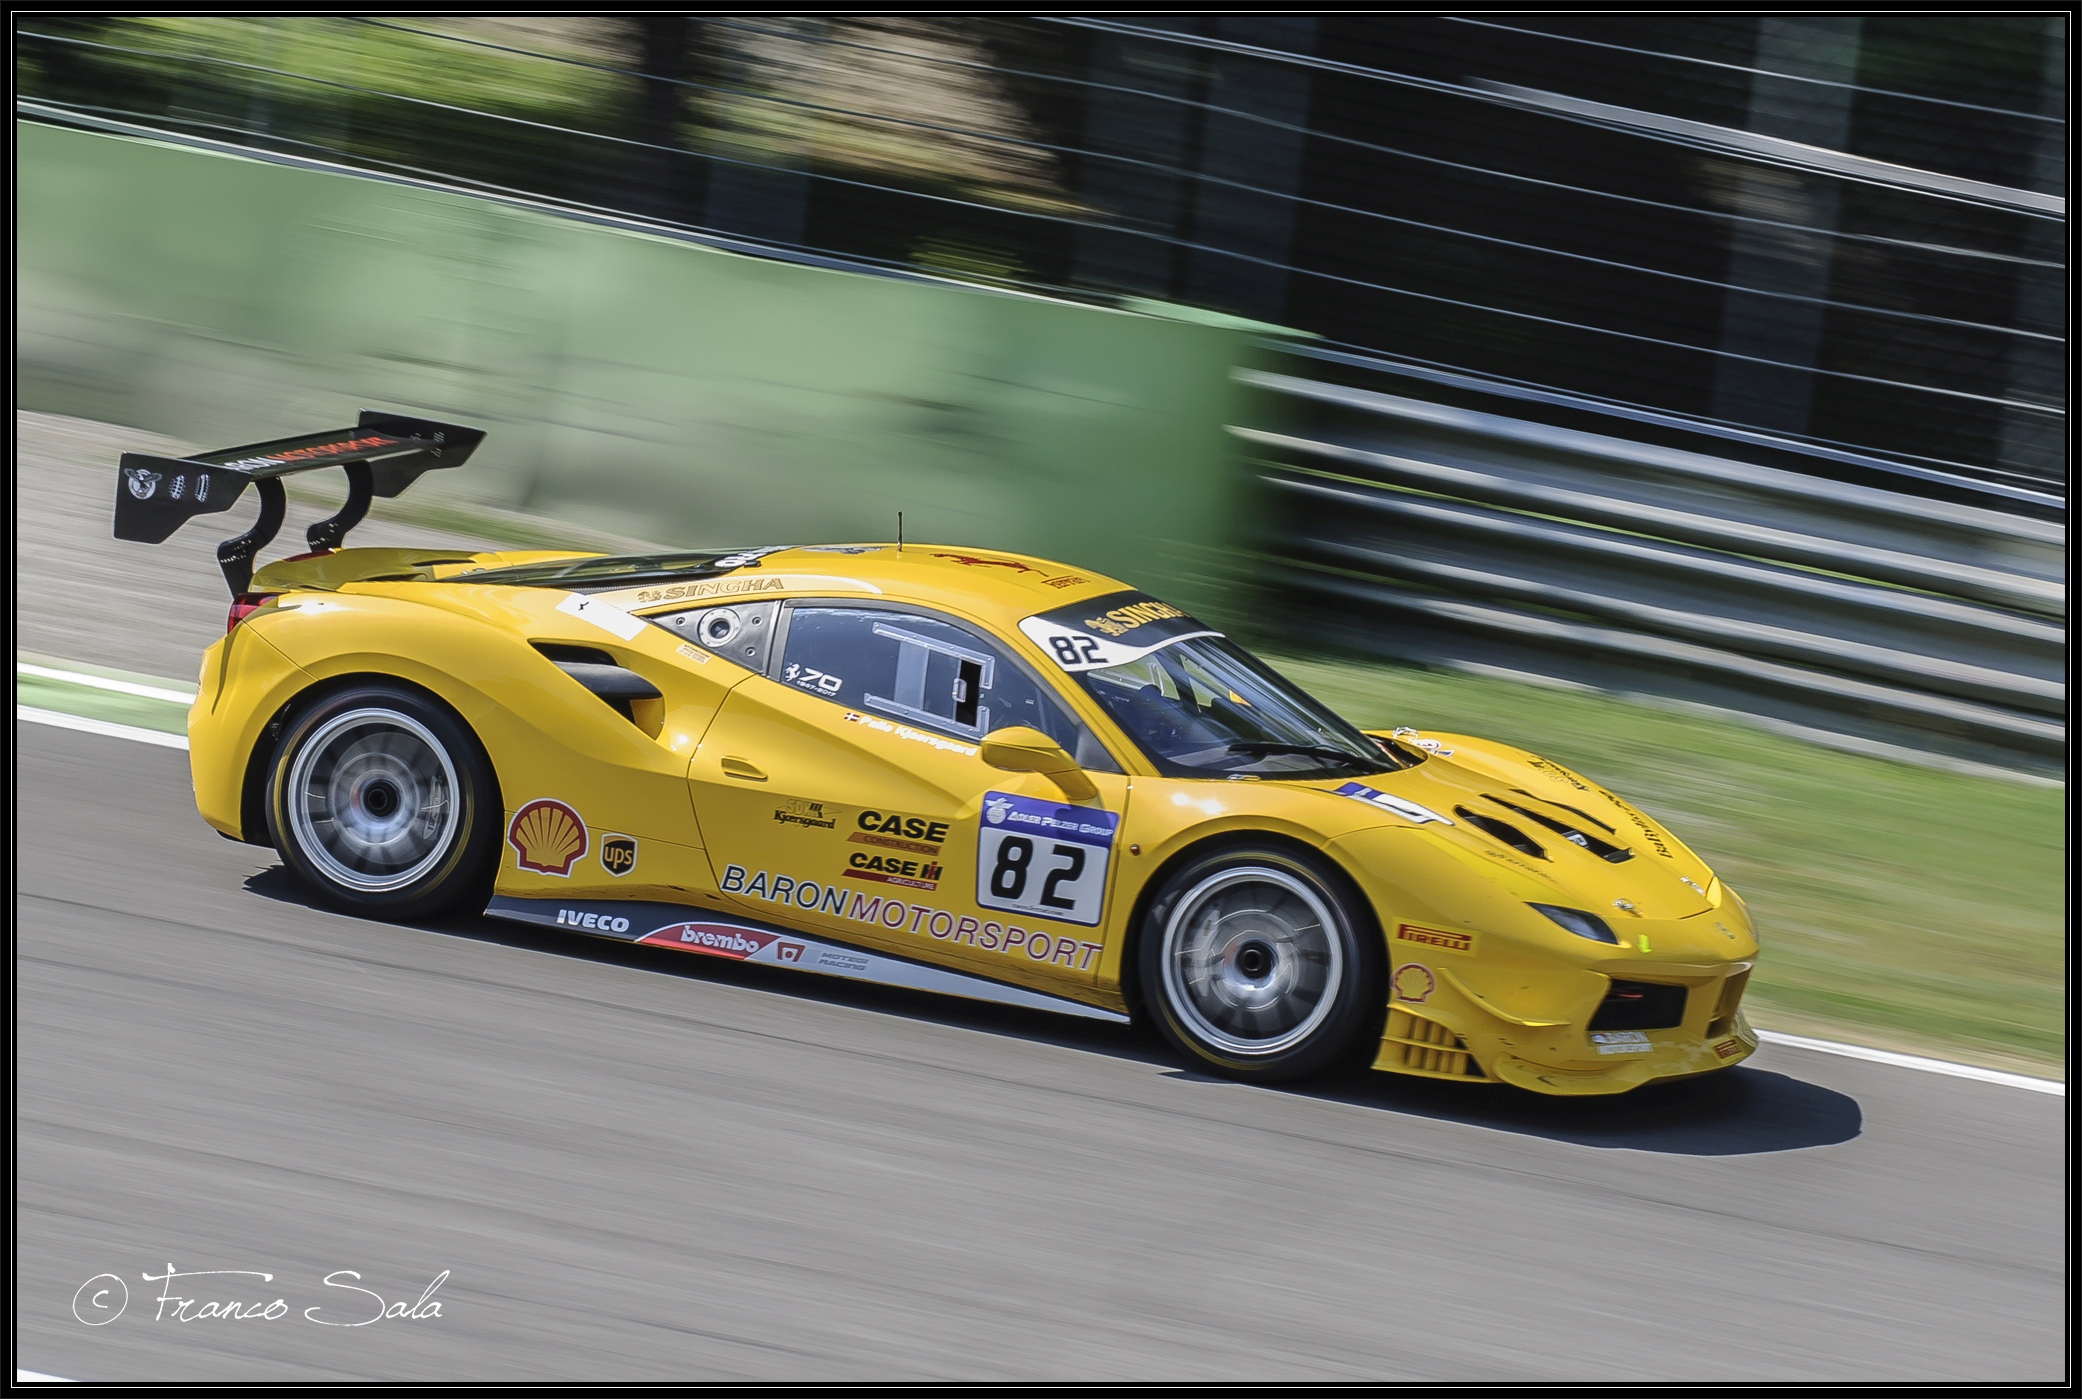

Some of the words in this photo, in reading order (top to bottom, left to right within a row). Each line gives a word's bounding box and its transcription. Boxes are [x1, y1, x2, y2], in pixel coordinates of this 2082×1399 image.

[663, 578, 784, 600] SINGHA
[1048, 635, 1110, 665] 82
[799, 667, 843, 692] 70
[857, 810, 950, 843] CASE
[863, 835, 938, 854] CONSTRUCTION
[604, 846, 633, 869] ups
[849, 852, 918, 876] CASE
[886, 876, 935, 890] AGRICULTURE
[990, 835, 1085, 910] 82
[556, 909, 630, 933] IVECO
[720, 863, 849, 917] BARON
[847, 891, 1103, 971] MOTORSPORT
[680, 925, 760, 954] brembo
[1397, 923, 1473, 951] PIRELLI
[821, 952, 869, 965] MOTEGI
